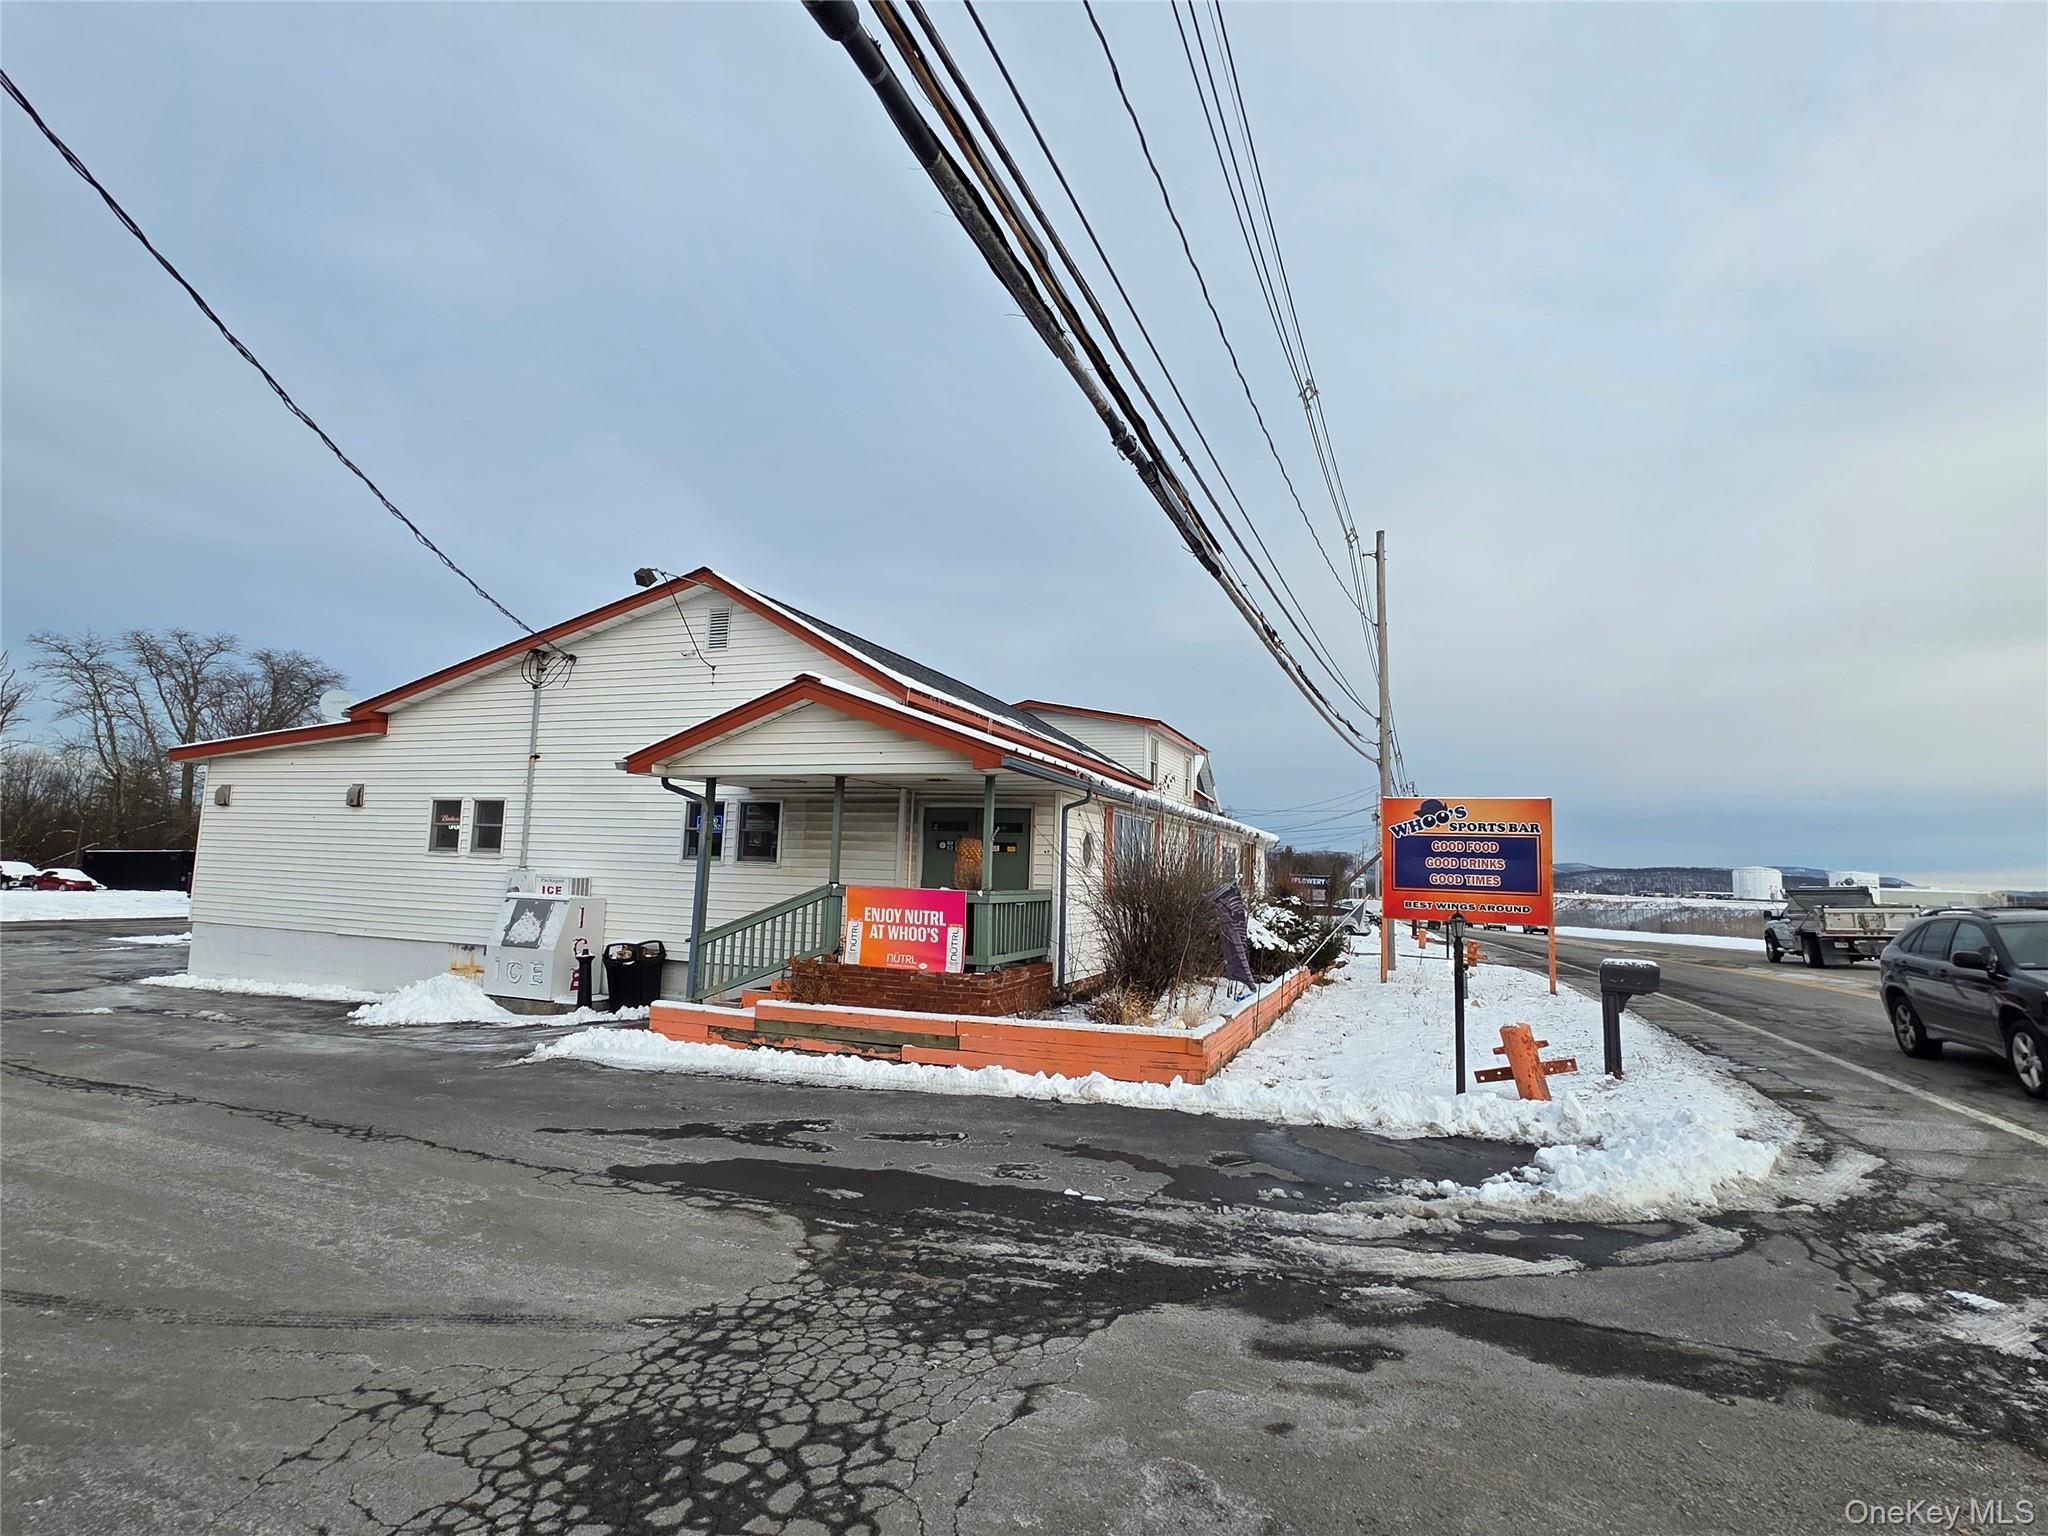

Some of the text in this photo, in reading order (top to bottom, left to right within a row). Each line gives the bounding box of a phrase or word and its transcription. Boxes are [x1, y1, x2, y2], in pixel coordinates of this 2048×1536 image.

[1389, 805, 1468, 839] WHOO'S
[1449, 822, 1542, 834] SPORTS BAR
[1431, 841, 1500, 853] GOOD FOOD
[1425, 857, 1506, 870] GOOD DRINKS
[1429, 874, 1502, 886] GOOD TIMES
[541, 885, 562, 895] ICE
[1404, 901, 1532, 913] BEST WINGS AROUND
[864, 907, 946, 927] ENJOY NUTRL
[869, 924, 939, 943] AT WHOO'S
[494, 958, 545, 986] ICE
